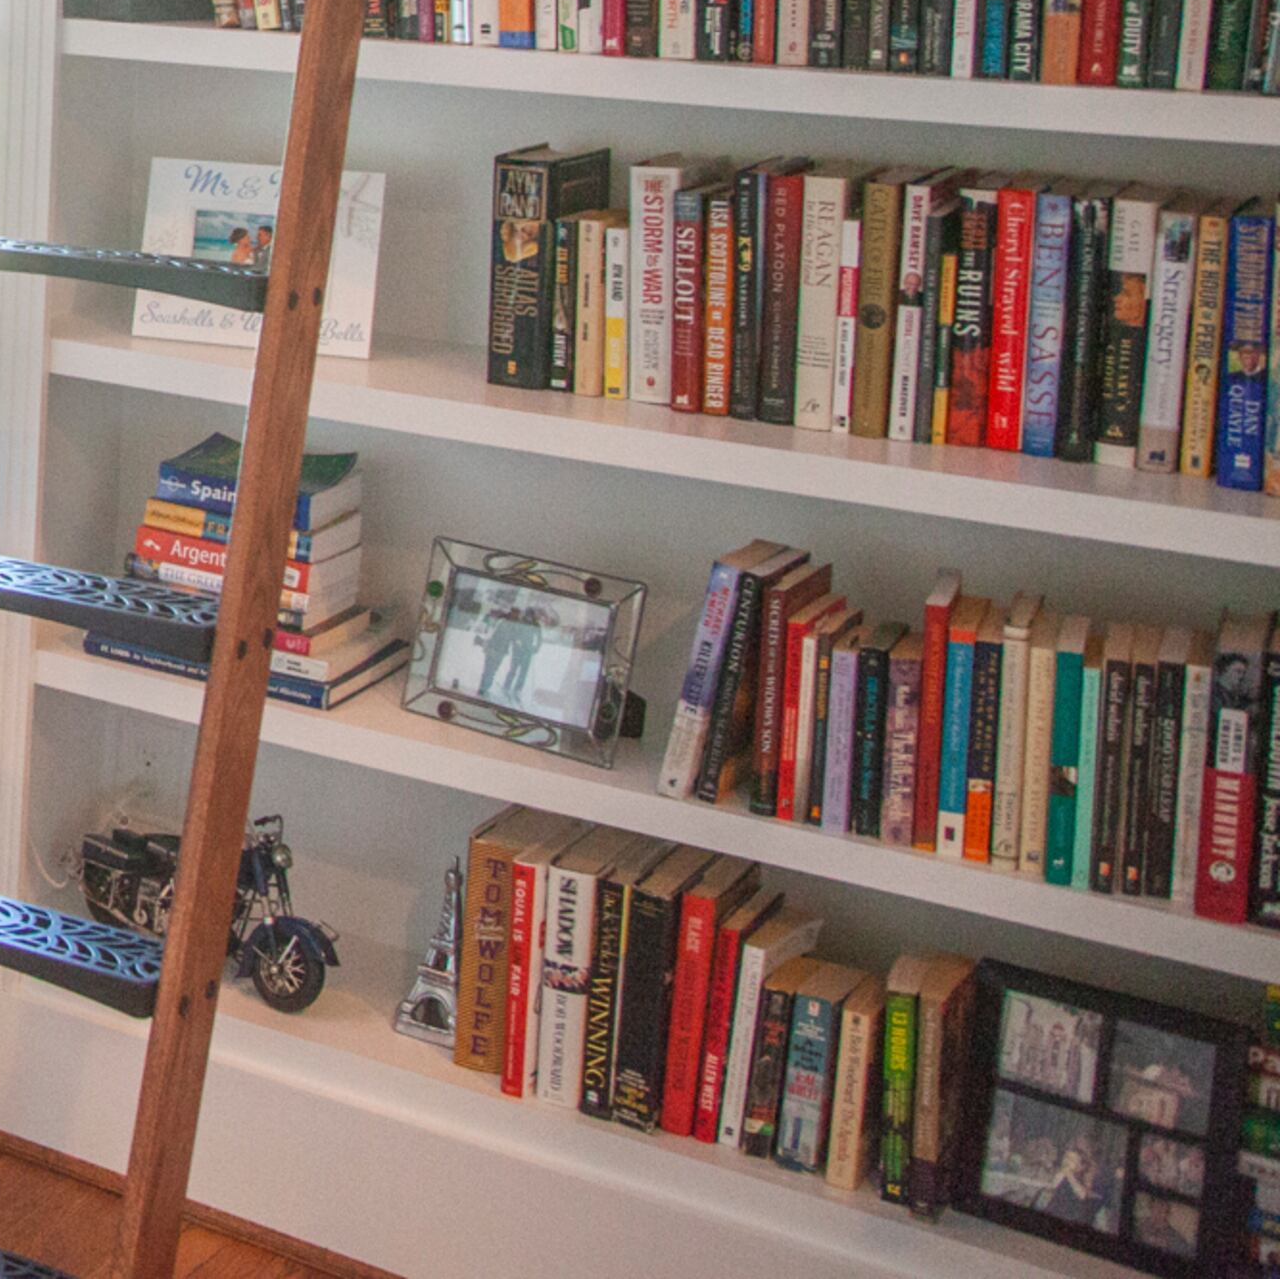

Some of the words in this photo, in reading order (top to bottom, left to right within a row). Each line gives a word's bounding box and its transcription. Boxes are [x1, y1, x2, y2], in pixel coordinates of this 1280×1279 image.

[1126, 0, 1142, 13] of
[1123, 16, 1143, 55] DUTY
[1013, 42, 1032, 74] CITY
[183, 164, 233, 197] Mr
[236, 175, 261, 200] &
[505, 172, 538, 195] AYN
[498, 195, 540, 219] RAND
[709, 199, 728, 228] LISA
[805, 213, 815, 231] His
[911, 195, 924, 221] DAVE
[804, 234, 814, 255] Own
[815, 200, 837, 288] REAGAN
[907, 225, 923, 270] RAMSEY
[1036, 220, 1065, 289] BEN
[1128, 219, 1140, 252] GAIL
[612, 262, 624, 279] AYN
[675, 225, 696, 325] SELLOUT
[708, 232, 728, 307] SCOTTOLINE
[802, 257, 814, 287] Hand
[962, 251, 974, 267] THE
[1236, 223, 1268, 300] STANDING
[490, 264, 516, 354] SHRUGGED
[515, 267, 540, 318] ATLAS
[611, 280, 623, 302] RAND
[953, 269, 984, 337] RUINS
[140, 300, 215, 330] Seashells
[219, 311, 234, 330] &
[320, 318, 366, 346] Bells
[1151, 268, 1184, 367] Strategery
[1233, 302, 1265, 343] FIRM
[707, 327, 726, 358] DEAD
[707, 363, 726, 408] RINGER
[1026, 322, 1060, 426] SASSE
[1103, 344, 1116, 399] CHOICE
[1226, 384, 1246, 447] QUAYLE
[1244, 400, 1261, 435] DAN
[191, 480, 236, 503] Spain
[710, 586, 731, 636] MICHAEL
[694, 640, 714, 680] KILLER
[1210, 777, 1240, 859] MANHUNT
[1263, 796, 1280, 831] Jesse
[1259, 832, 1277, 889] Jackson
[476, 857, 507, 933] TOM
[602, 889, 620, 920] Jack
[554, 876, 578, 960] SHADOW
[598, 926, 618, 974] Welch
[470, 937, 504, 1059] WOLFE
[553, 992, 568, 1020] BOB
[583, 977, 614, 1089] WINNING
[892, 1011, 908, 1024] 13
[549, 1021, 567, 1091] WOODWARD
[849, 1034, 862, 1053] Bob
[891, 1026, 908, 1071] HOURS
[703, 1053, 720, 1083] ALLEN
[842, 1055, 859, 1106] Woodward
[701, 1083, 717, 1113] WEST
[842, 1109, 856, 1125] The
[837, 1126, 854, 1163] Agenda
